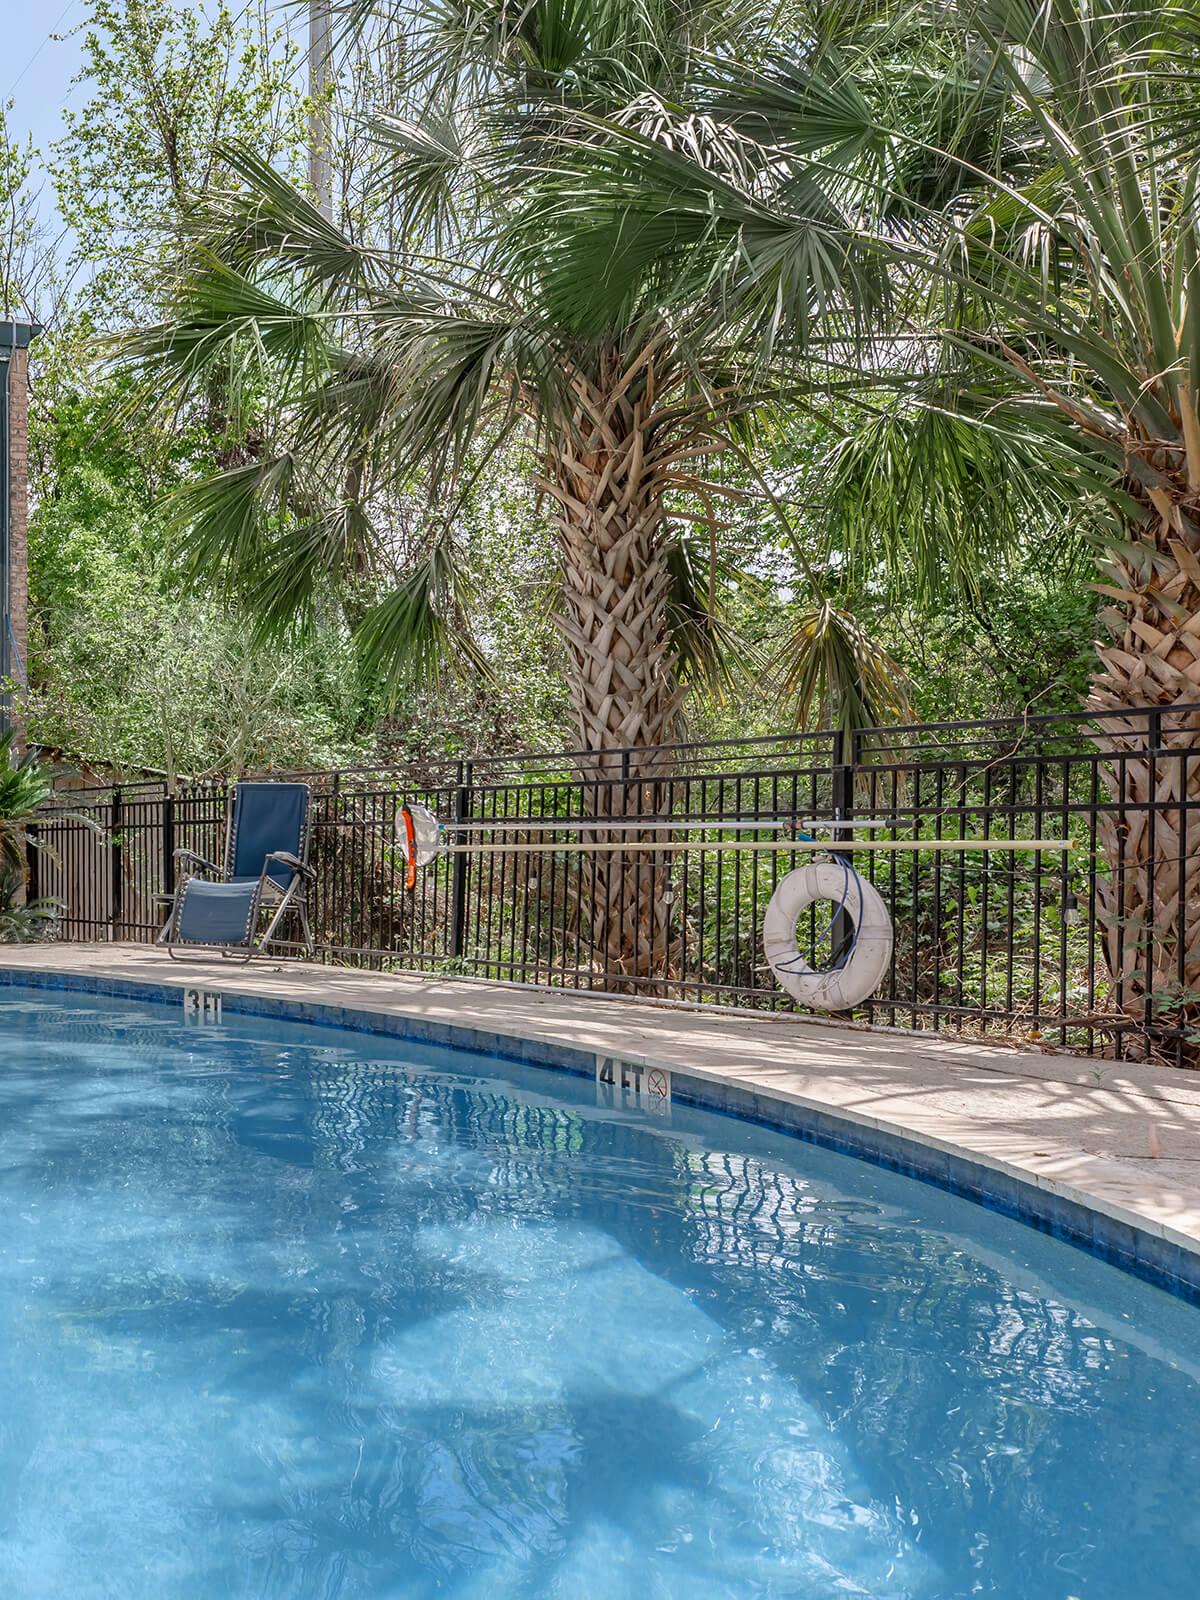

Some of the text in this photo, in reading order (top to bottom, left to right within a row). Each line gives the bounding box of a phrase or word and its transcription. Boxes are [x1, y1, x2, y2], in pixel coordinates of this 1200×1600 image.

[187, 990, 221, 1010] 3 FT
[600, 1058, 644, 1093] 4 FT
